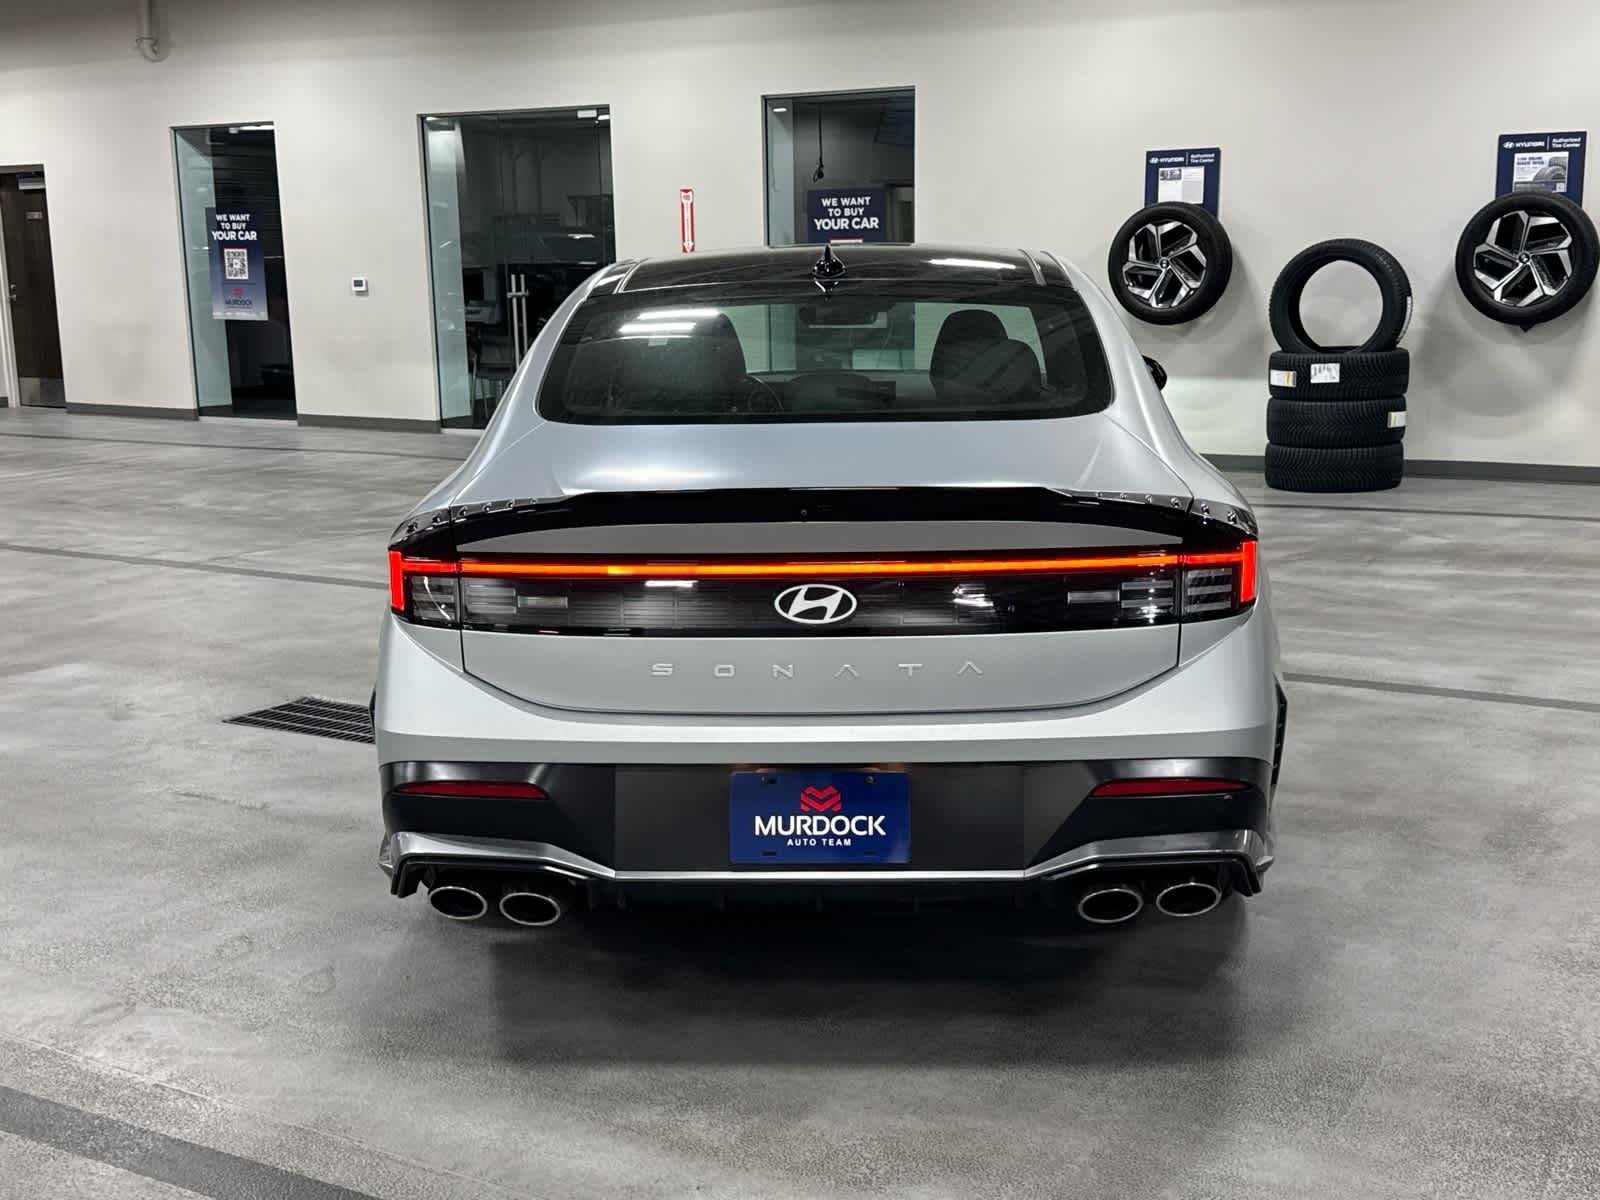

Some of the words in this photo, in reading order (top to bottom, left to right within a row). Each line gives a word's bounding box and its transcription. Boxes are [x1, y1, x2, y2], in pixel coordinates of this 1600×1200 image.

[821, 198, 838, 207] WE
[840, 196, 871, 206] WANT
[828, 208, 841, 217] TO
[844, 207, 864, 216] BUY
[220, 222, 231, 230] TO
[232, 222, 246, 230] BUY
[814, 218, 849, 230] YOUR
[851, 217, 879, 229] CAR
[212, 231, 237, 241] YOUR
[238, 231, 257, 240] CAR
[652, 661, 983, 679] SONATA
[754, 815, 886, 836] MURDOCK
[787, 838, 817, 846] AUTO
[822, 838, 852, 846] TEAM
